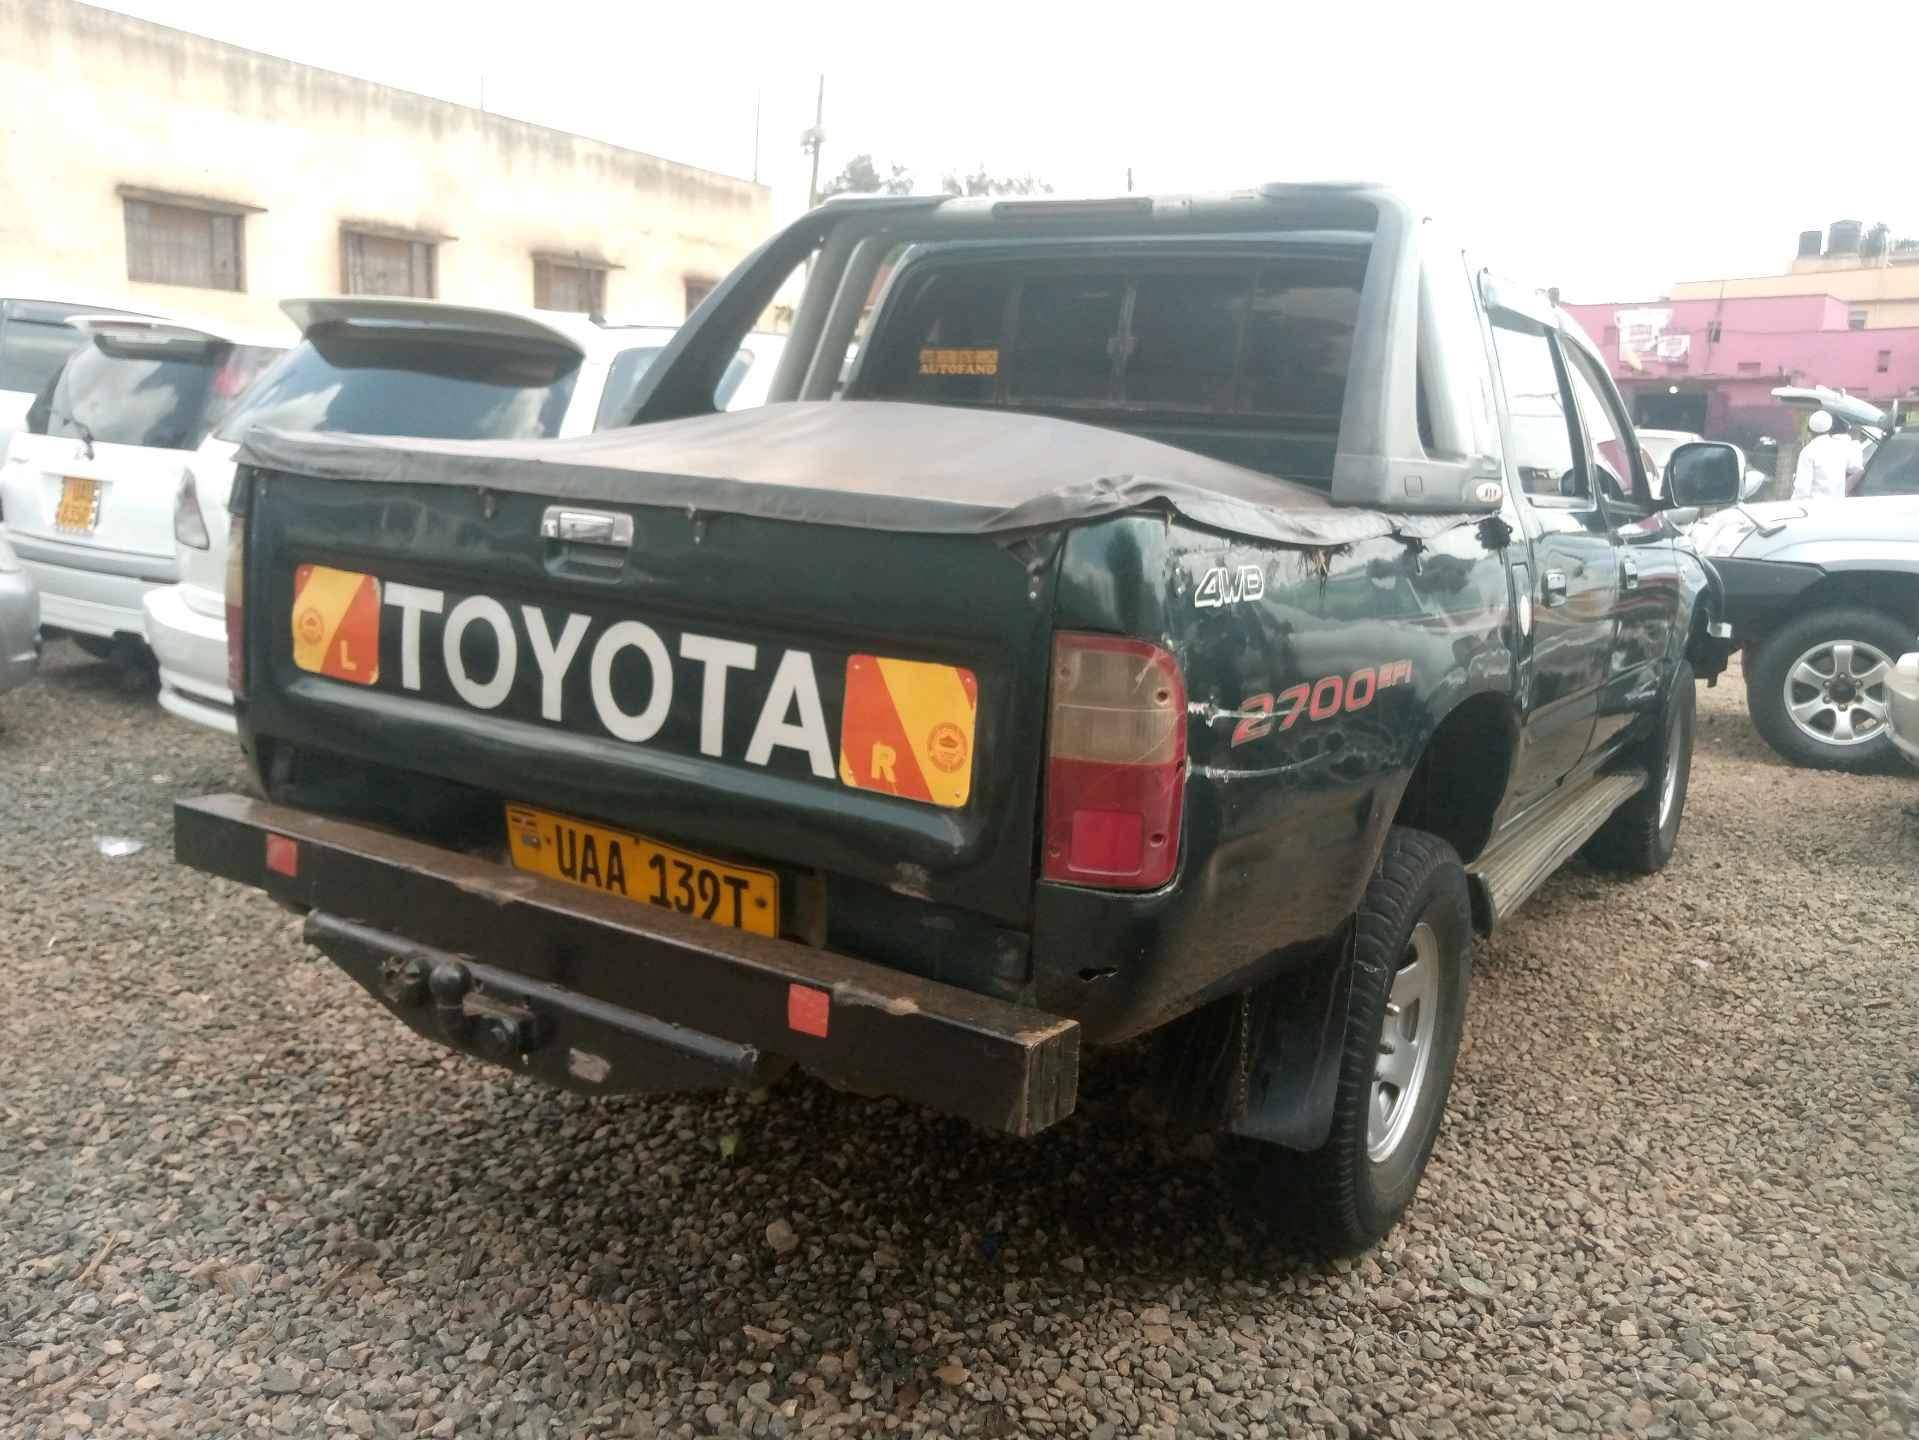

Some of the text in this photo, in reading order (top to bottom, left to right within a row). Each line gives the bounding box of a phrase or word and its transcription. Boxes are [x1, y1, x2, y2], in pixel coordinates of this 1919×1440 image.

[1194, 564, 1265, 608] 4WD
[340, 639, 357, 671] L
[384, 581, 837, 779] TOYOTA
[1231, 667, 1377, 749] 2700
[871, 742, 897, 784] R
[555, 824, 749, 929] UAA 139T
